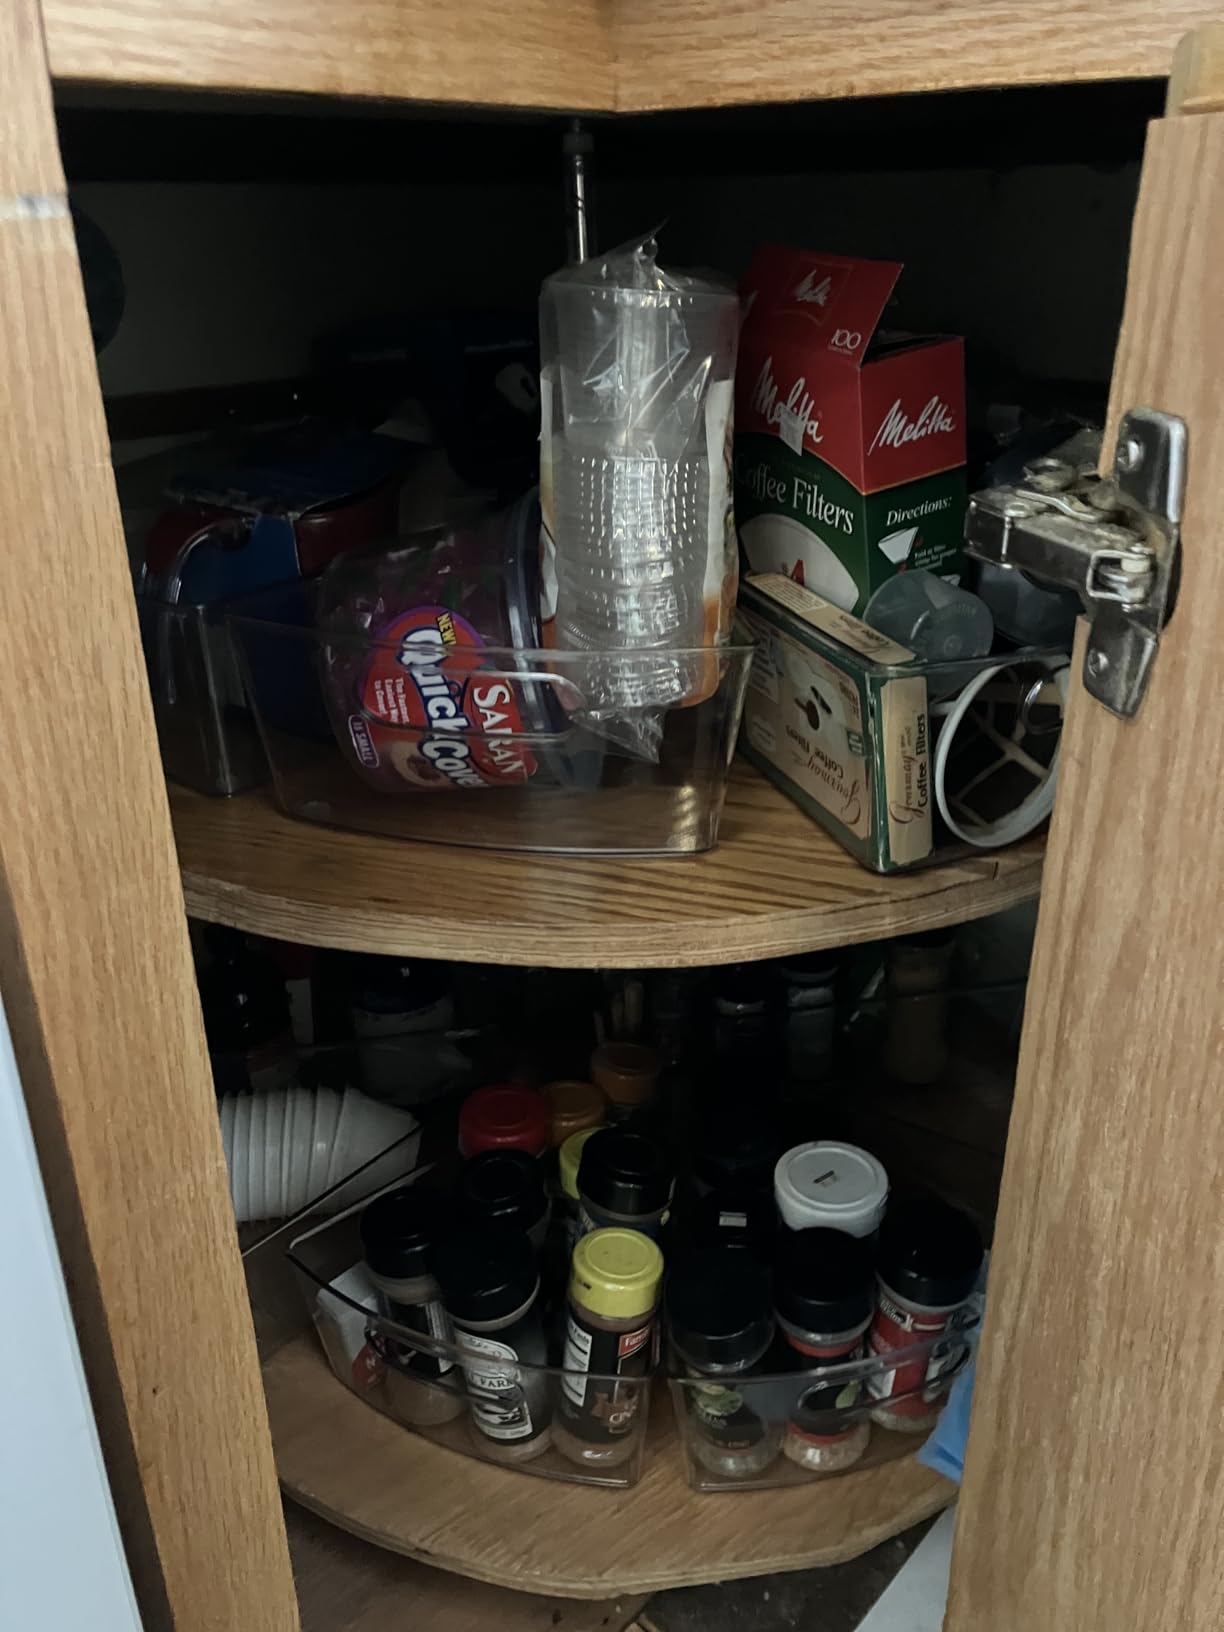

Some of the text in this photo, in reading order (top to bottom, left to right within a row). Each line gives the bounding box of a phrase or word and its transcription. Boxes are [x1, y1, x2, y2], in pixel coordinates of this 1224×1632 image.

[830, 329, 862, 350] 100
[751, 355, 825, 443] Meltta
[868, 395, 955, 456] Melitta
[735, 454, 854, 535] Coffee Filters
[886, 496, 953, 527] Directions:
[436, 611, 457, 646] NEW!
[399, 627, 471, 739] Quick
[473, 684, 525, 774] SARAN
[813, 746, 845, 780] Coffee
[915, 712, 928, 808] Coffee Filters
